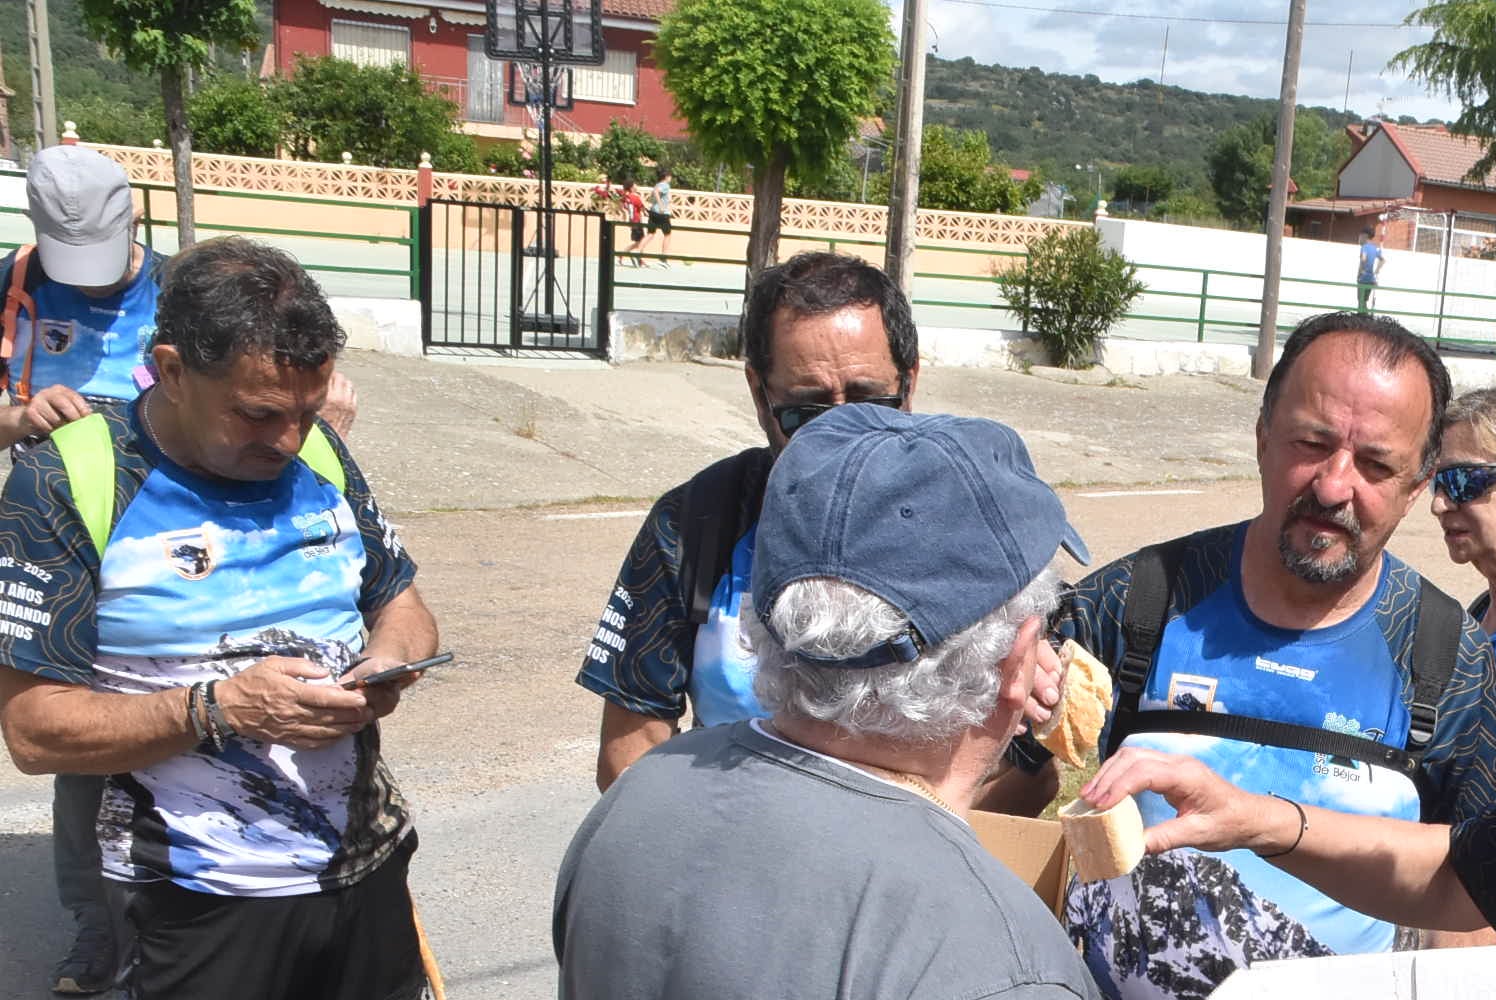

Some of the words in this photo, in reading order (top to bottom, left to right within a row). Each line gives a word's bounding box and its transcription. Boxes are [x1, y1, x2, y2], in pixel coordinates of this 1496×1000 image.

[0, 557, 14, 567] 02
[24, 562, 53, 583] 2022
[8, 581, 44, 604] AÑOS
[602, 604, 626, 630] ÑOS
[587, 643, 610, 664] TOS
